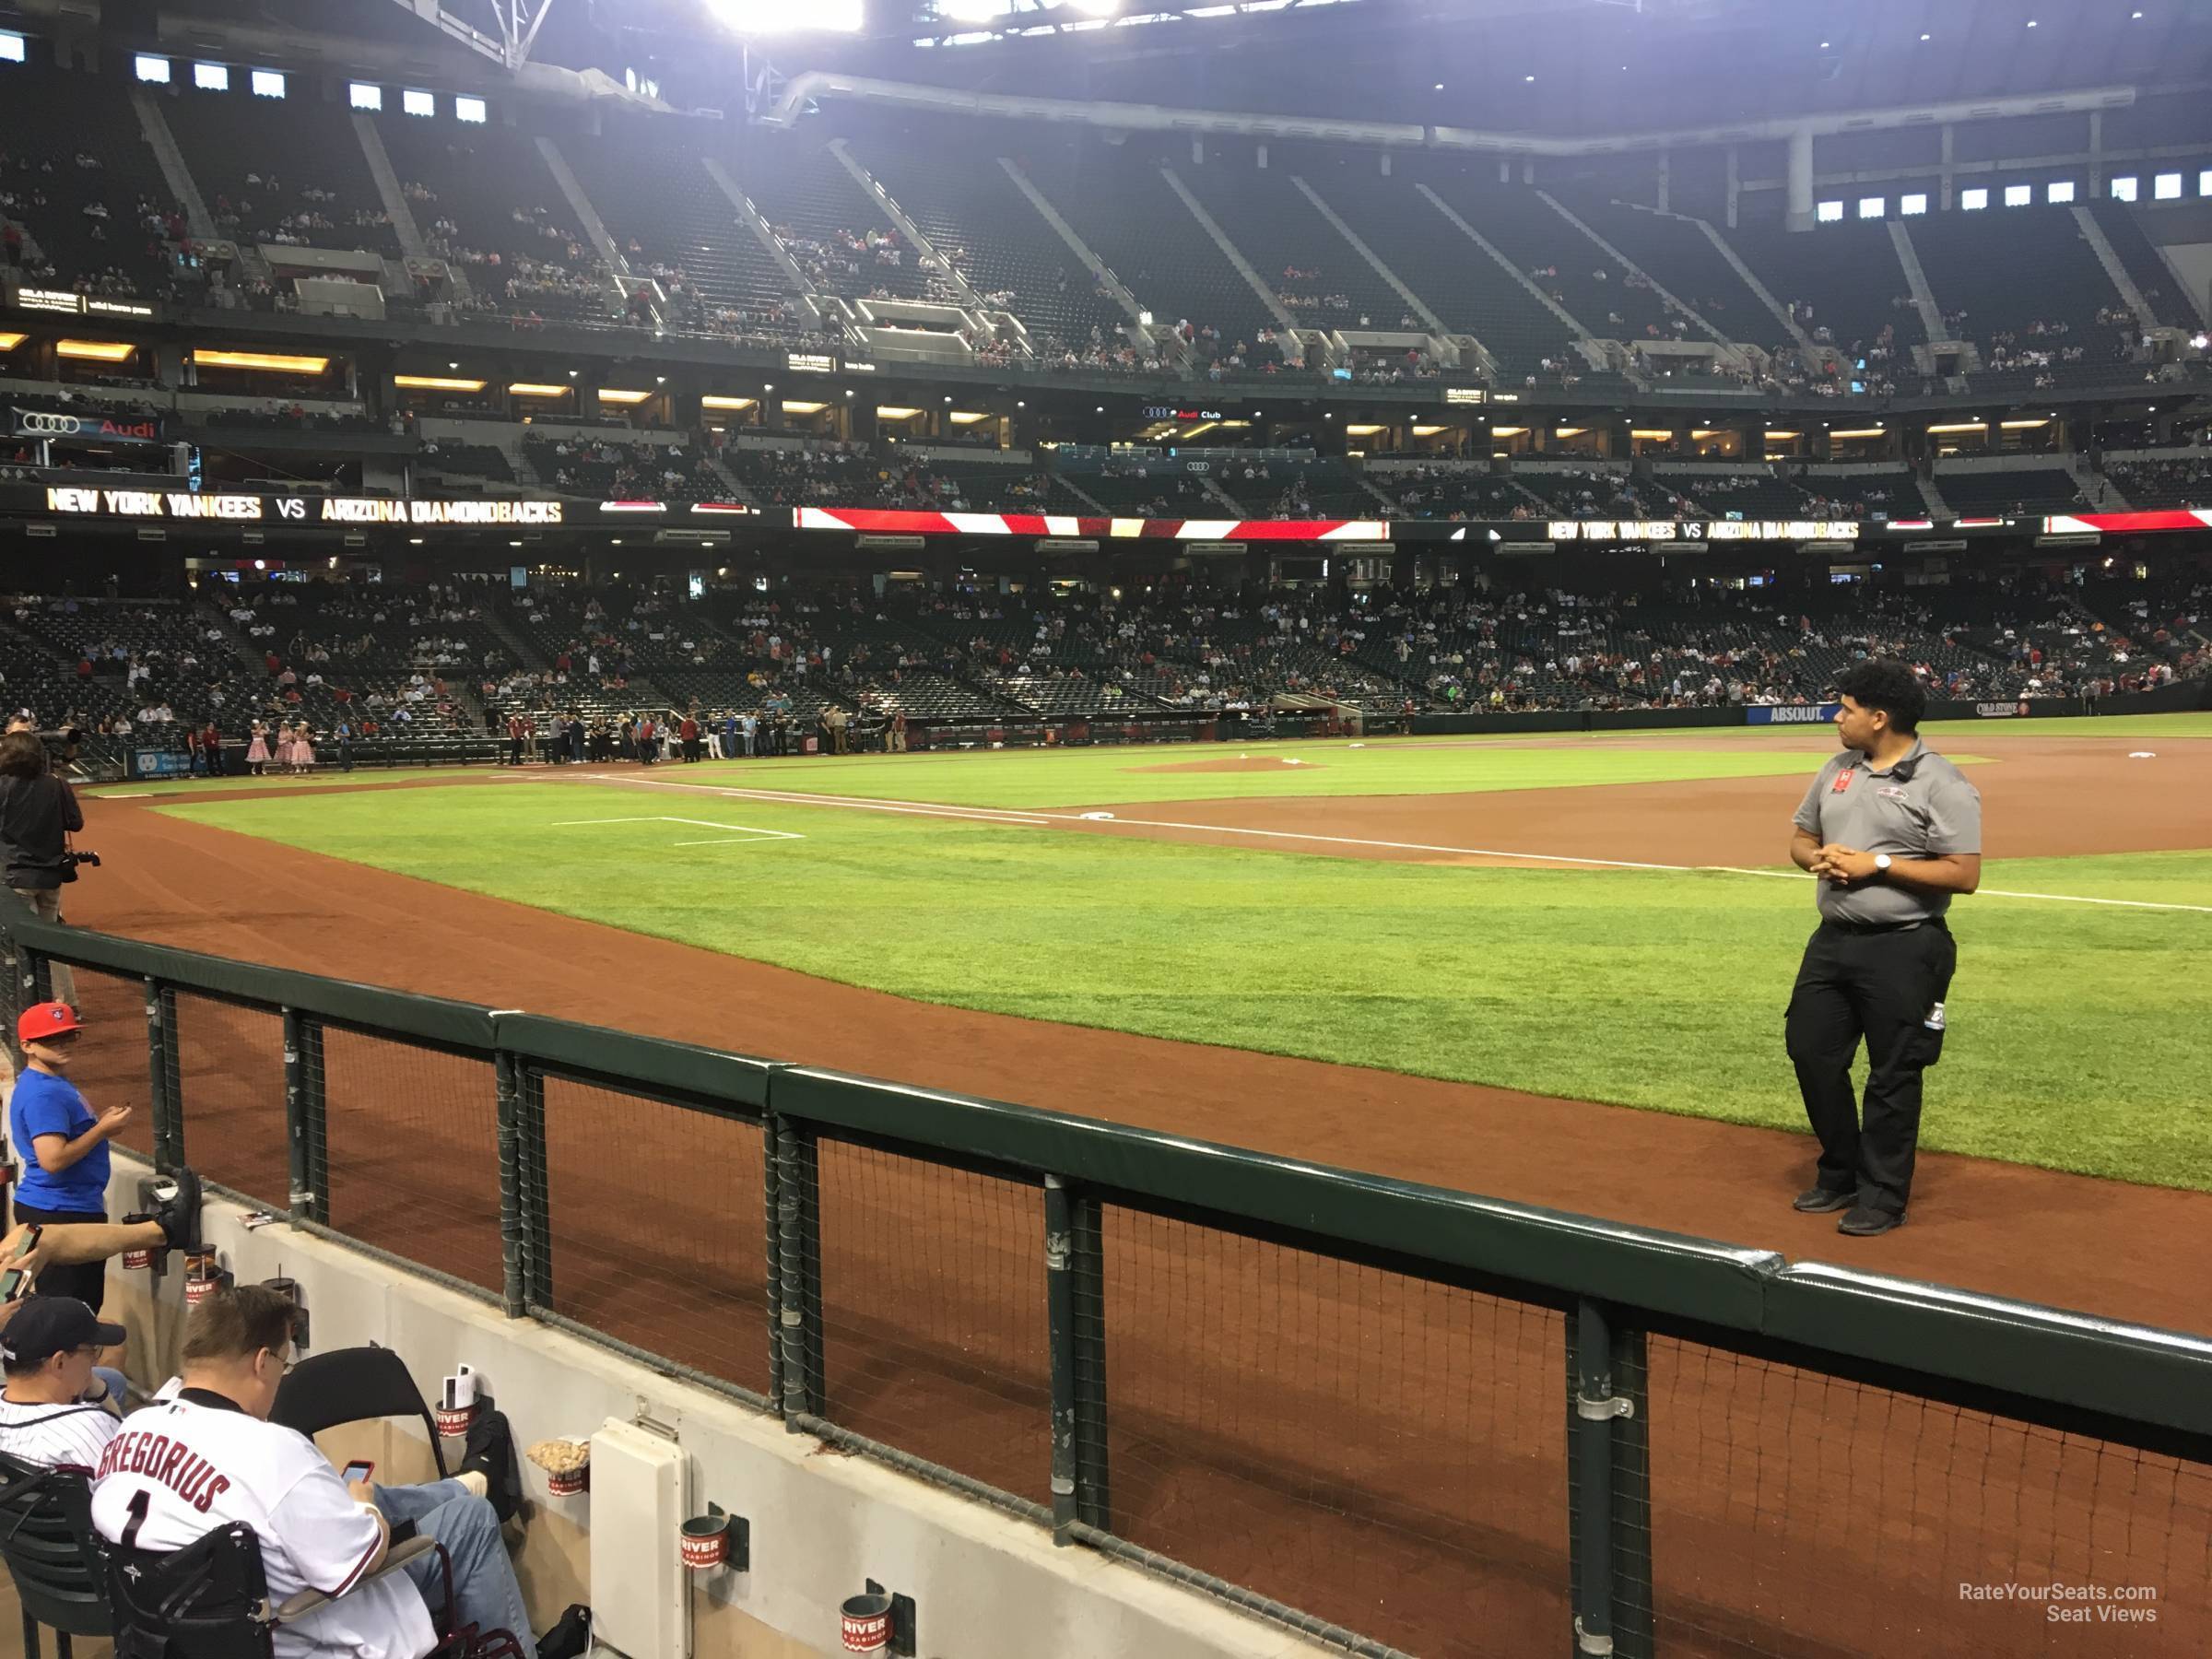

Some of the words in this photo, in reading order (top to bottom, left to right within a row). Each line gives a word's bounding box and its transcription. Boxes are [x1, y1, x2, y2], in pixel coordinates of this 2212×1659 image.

[1178, 410, 1198, 418] Audi
[100, 419, 155, 438] Audi
[47, 488, 99, 512] NEW
[103, 489, 163, 516] YORK
[167, 493, 262, 519] YANKEES
[276, 499, 306, 519] VS
[322, 499, 408, 522] ARIZONA
[411, 500, 562, 524] DIAMONDBACKS
[1547, 522, 1579, 539] NEW
[1581, 522, 1617, 539] YORK
[1618, 522, 1676, 539] YANKEES
[1683, 523, 1701, 538] VS
[1707, 522, 1761, 539] ARIZONA
[1762, 522, 1859, 539] DIAMONDBACKS
[1771, 707, 1825, 722] ABSOLUT.
[97, 1431, 230, 1514] GREGORIUS
[121, 1488, 151, 1548] 1
[844, 1618, 885, 1634] RIVER
